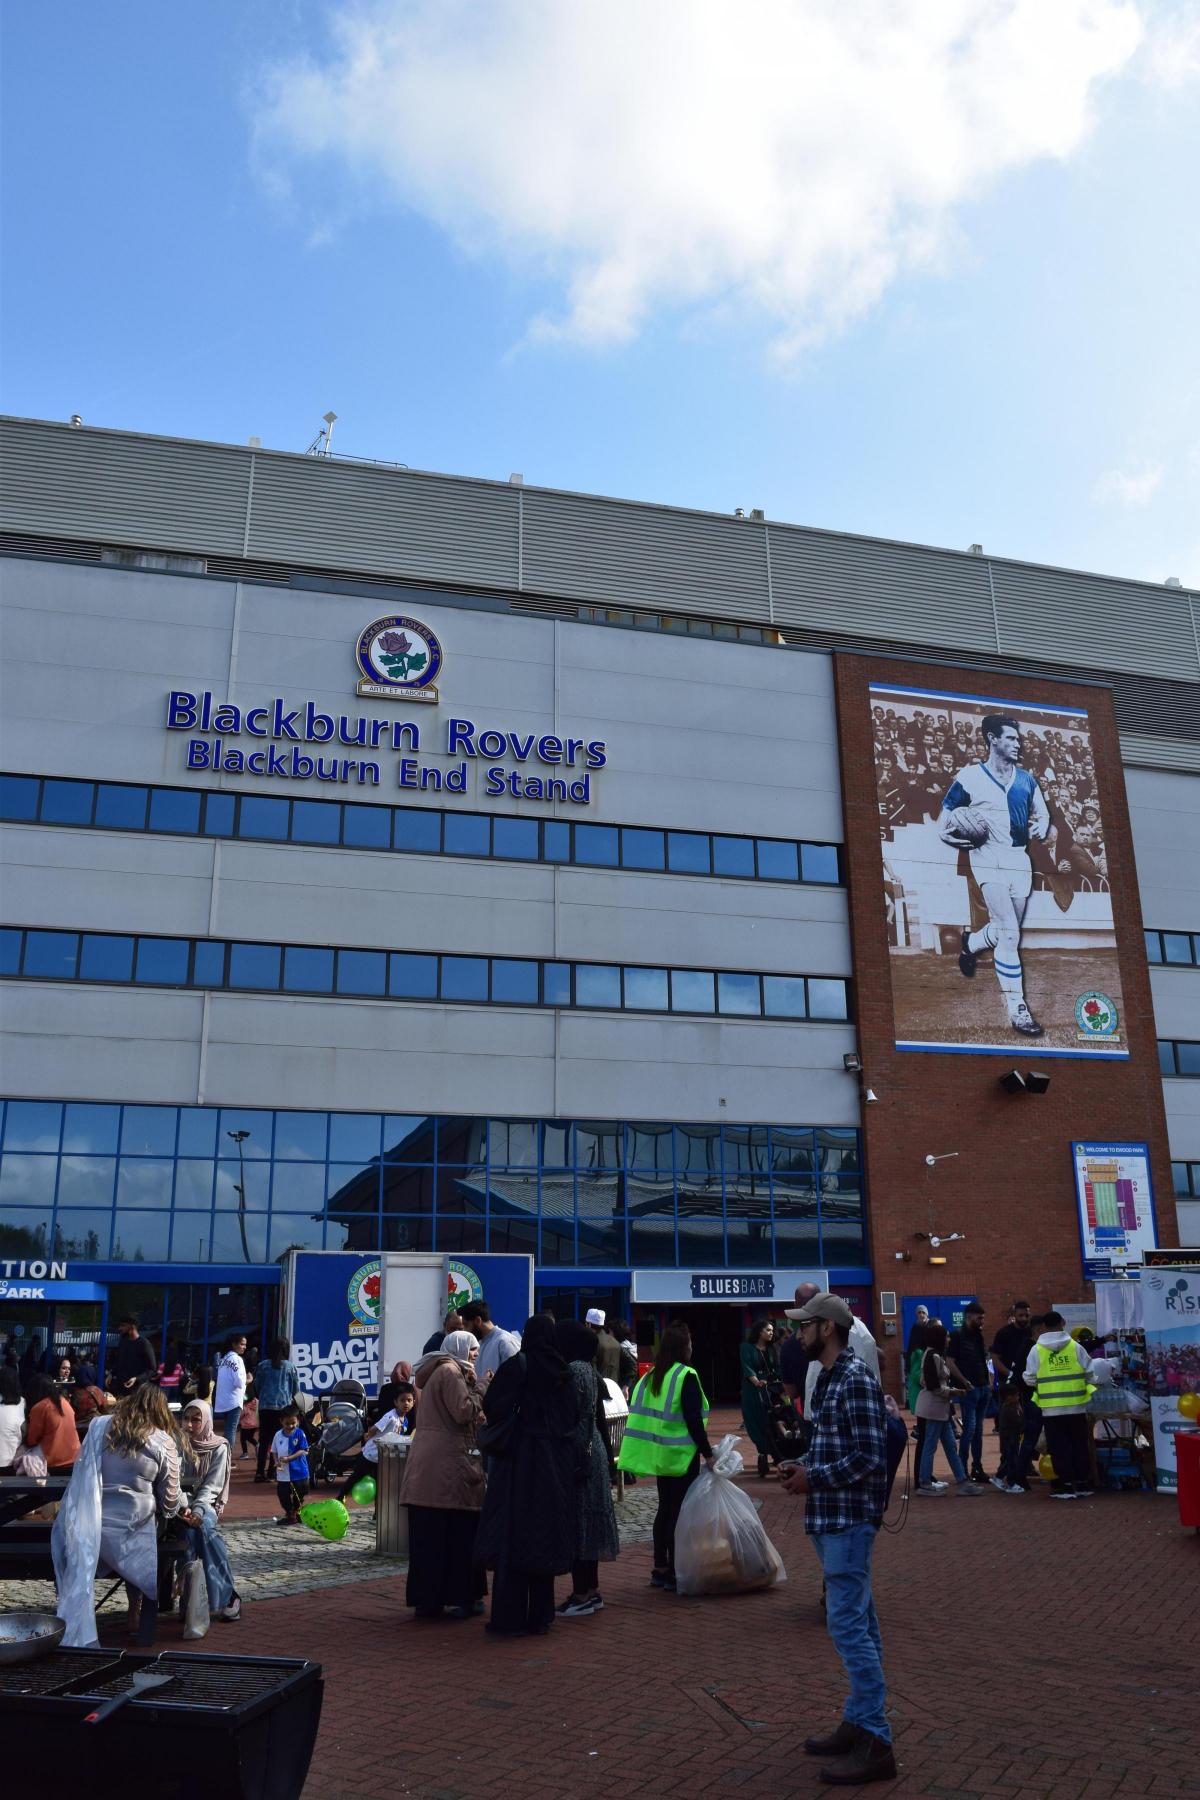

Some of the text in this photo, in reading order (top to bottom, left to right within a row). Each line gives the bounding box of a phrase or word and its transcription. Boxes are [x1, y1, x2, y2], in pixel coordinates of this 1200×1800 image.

[361, 619, 397, 654] BLACKBURN
[401, 619, 432, 641] ROVERS
[166, 690, 609, 769] Blackburn Rovers
[186, 739, 591, 804] Blackburn End Stand
[700, 1278, 765, 1294] BLUESBAR
[1165, 1296, 1200, 1311] RIS
